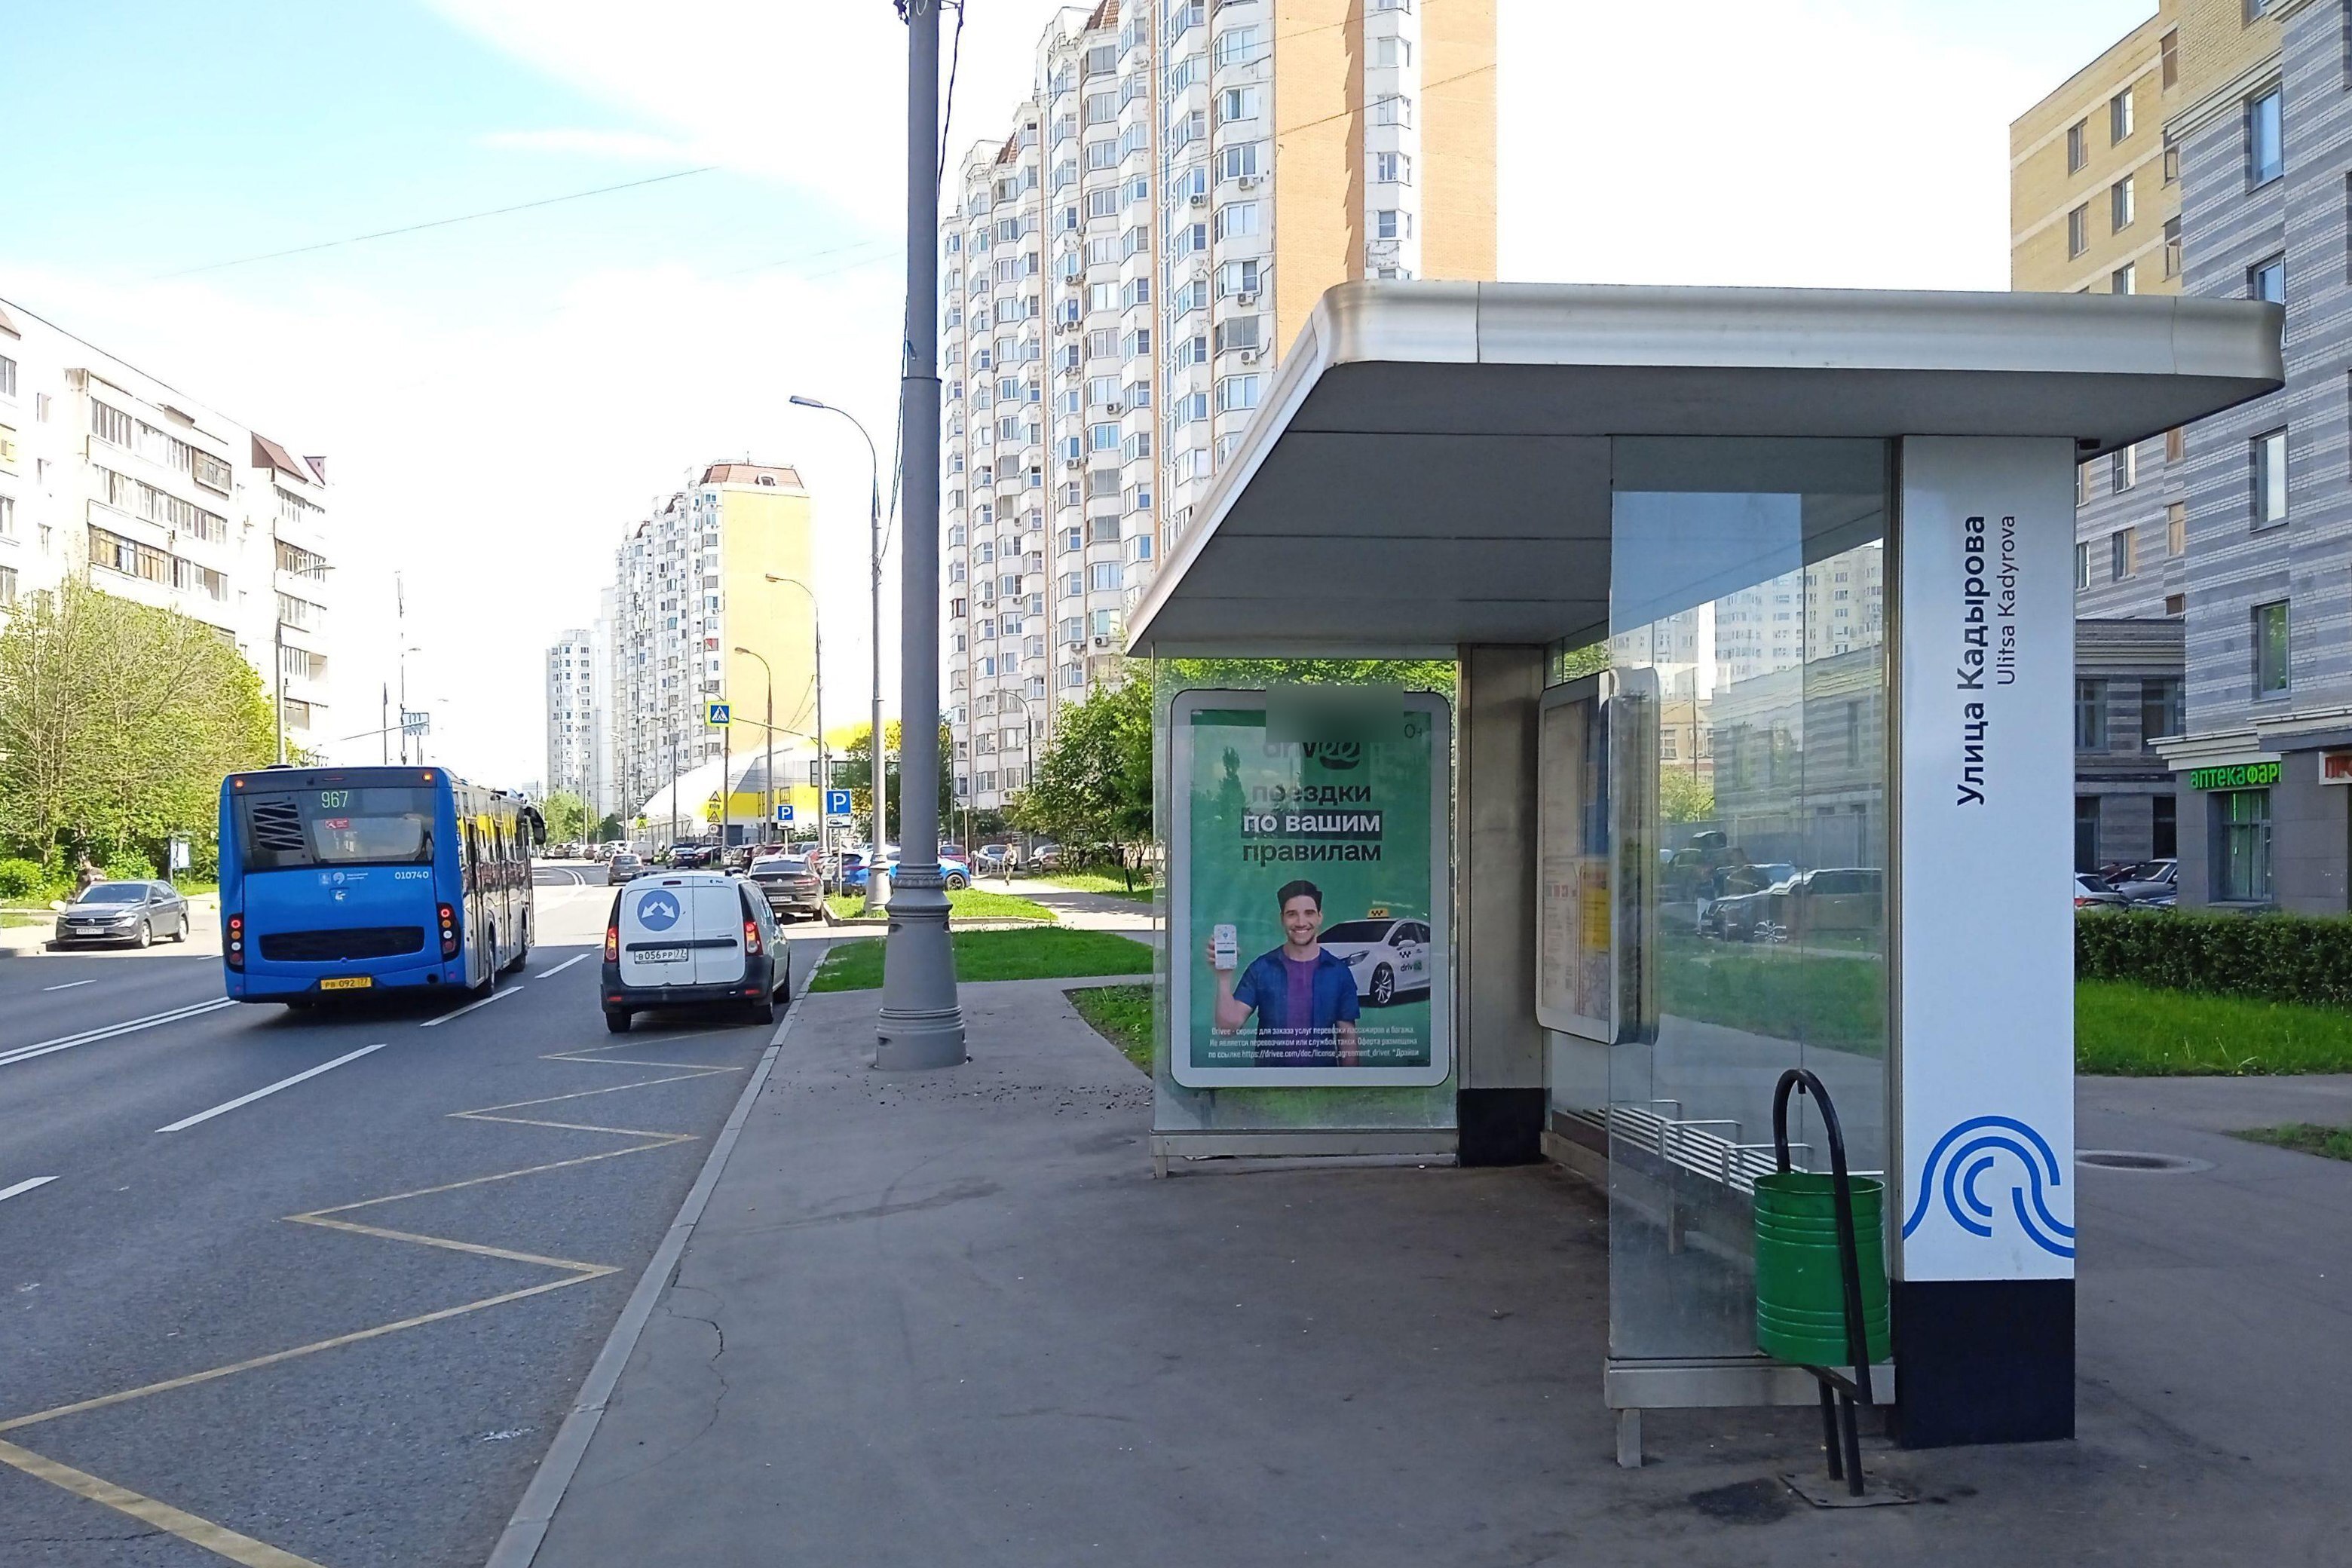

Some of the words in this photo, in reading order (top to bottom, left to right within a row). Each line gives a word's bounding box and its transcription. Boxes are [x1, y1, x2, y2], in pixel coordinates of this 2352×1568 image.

[1996, 516, 2019, 617] Kadyrova
[1957, 516, 1990, 689] Кадырова
[1996, 625, 2016, 684] Ulitsa
[1957, 703, 1989, 806] Улица
[321, 791, 348, 808] 967
[833, 793, 847, 812] P
[1252, 786, 1371, 806] поездки
[781, 807, 791, 819] P
[1244, 815, 1278, 832] по
[1285, 815, 1380, 832] вашим
[1244, 844, 1381, 868] правилам
[395, 871, 429, 880] 010740
